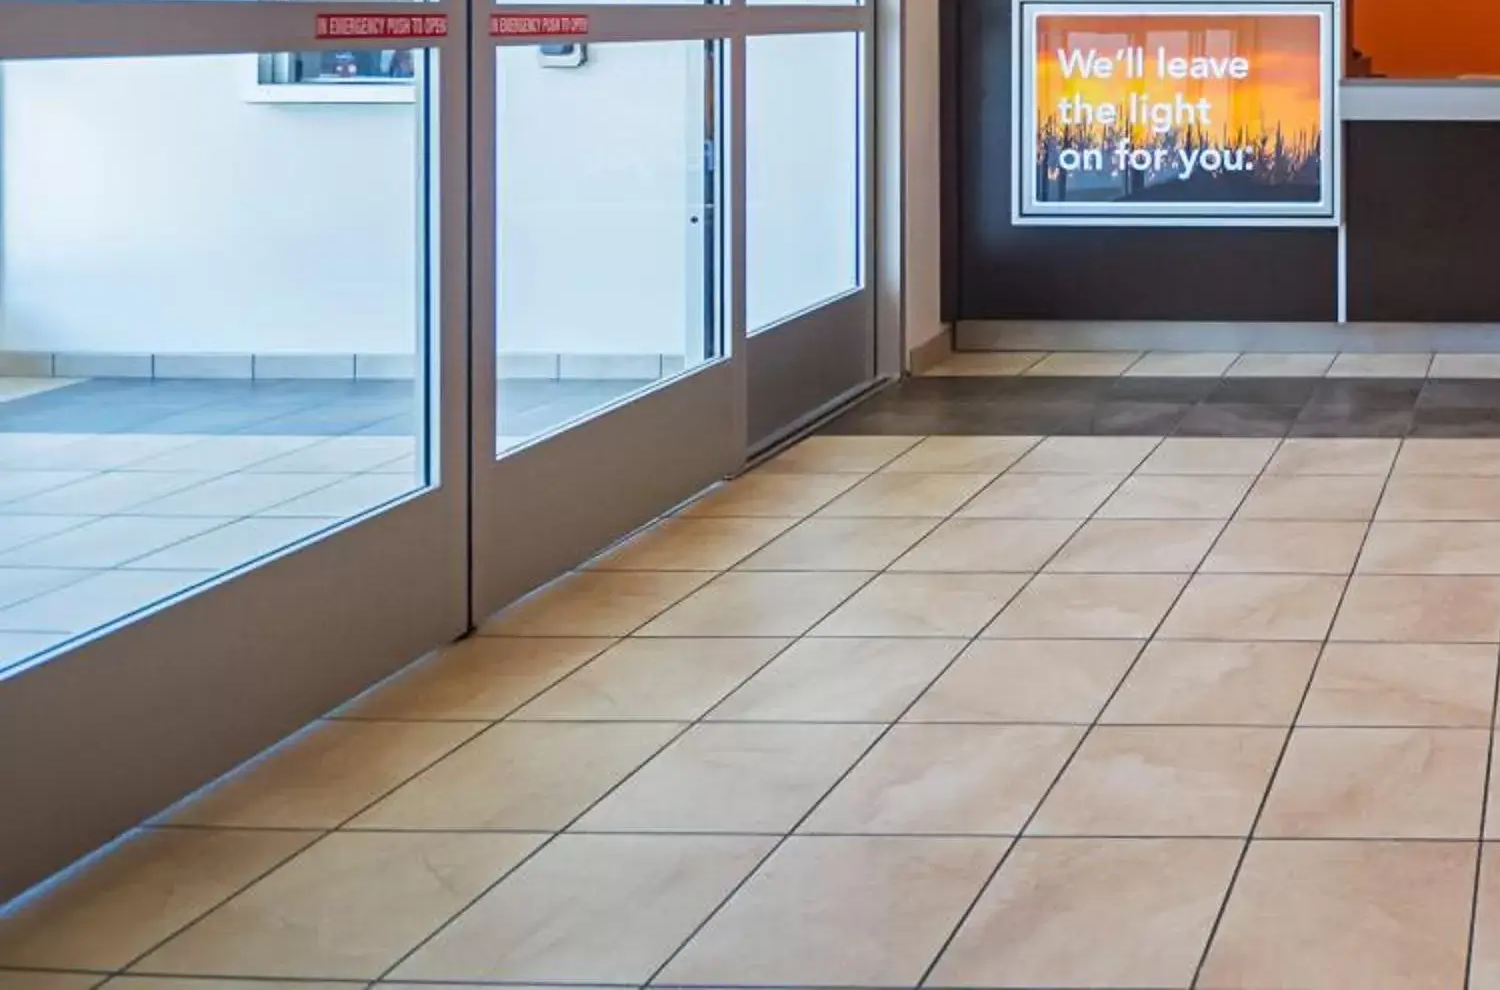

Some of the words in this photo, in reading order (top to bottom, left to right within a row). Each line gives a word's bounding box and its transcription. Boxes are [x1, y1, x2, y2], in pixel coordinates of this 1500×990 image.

[1057, 47, 1143, 79] We'll
[1157, 47, 1249, 79] leave
[1058, 93, 1117, 125] the
[1130, 92, 1211, 132] light
[1059, 146, 1102, 170] on
[1116, 137, 1167, 170] for
